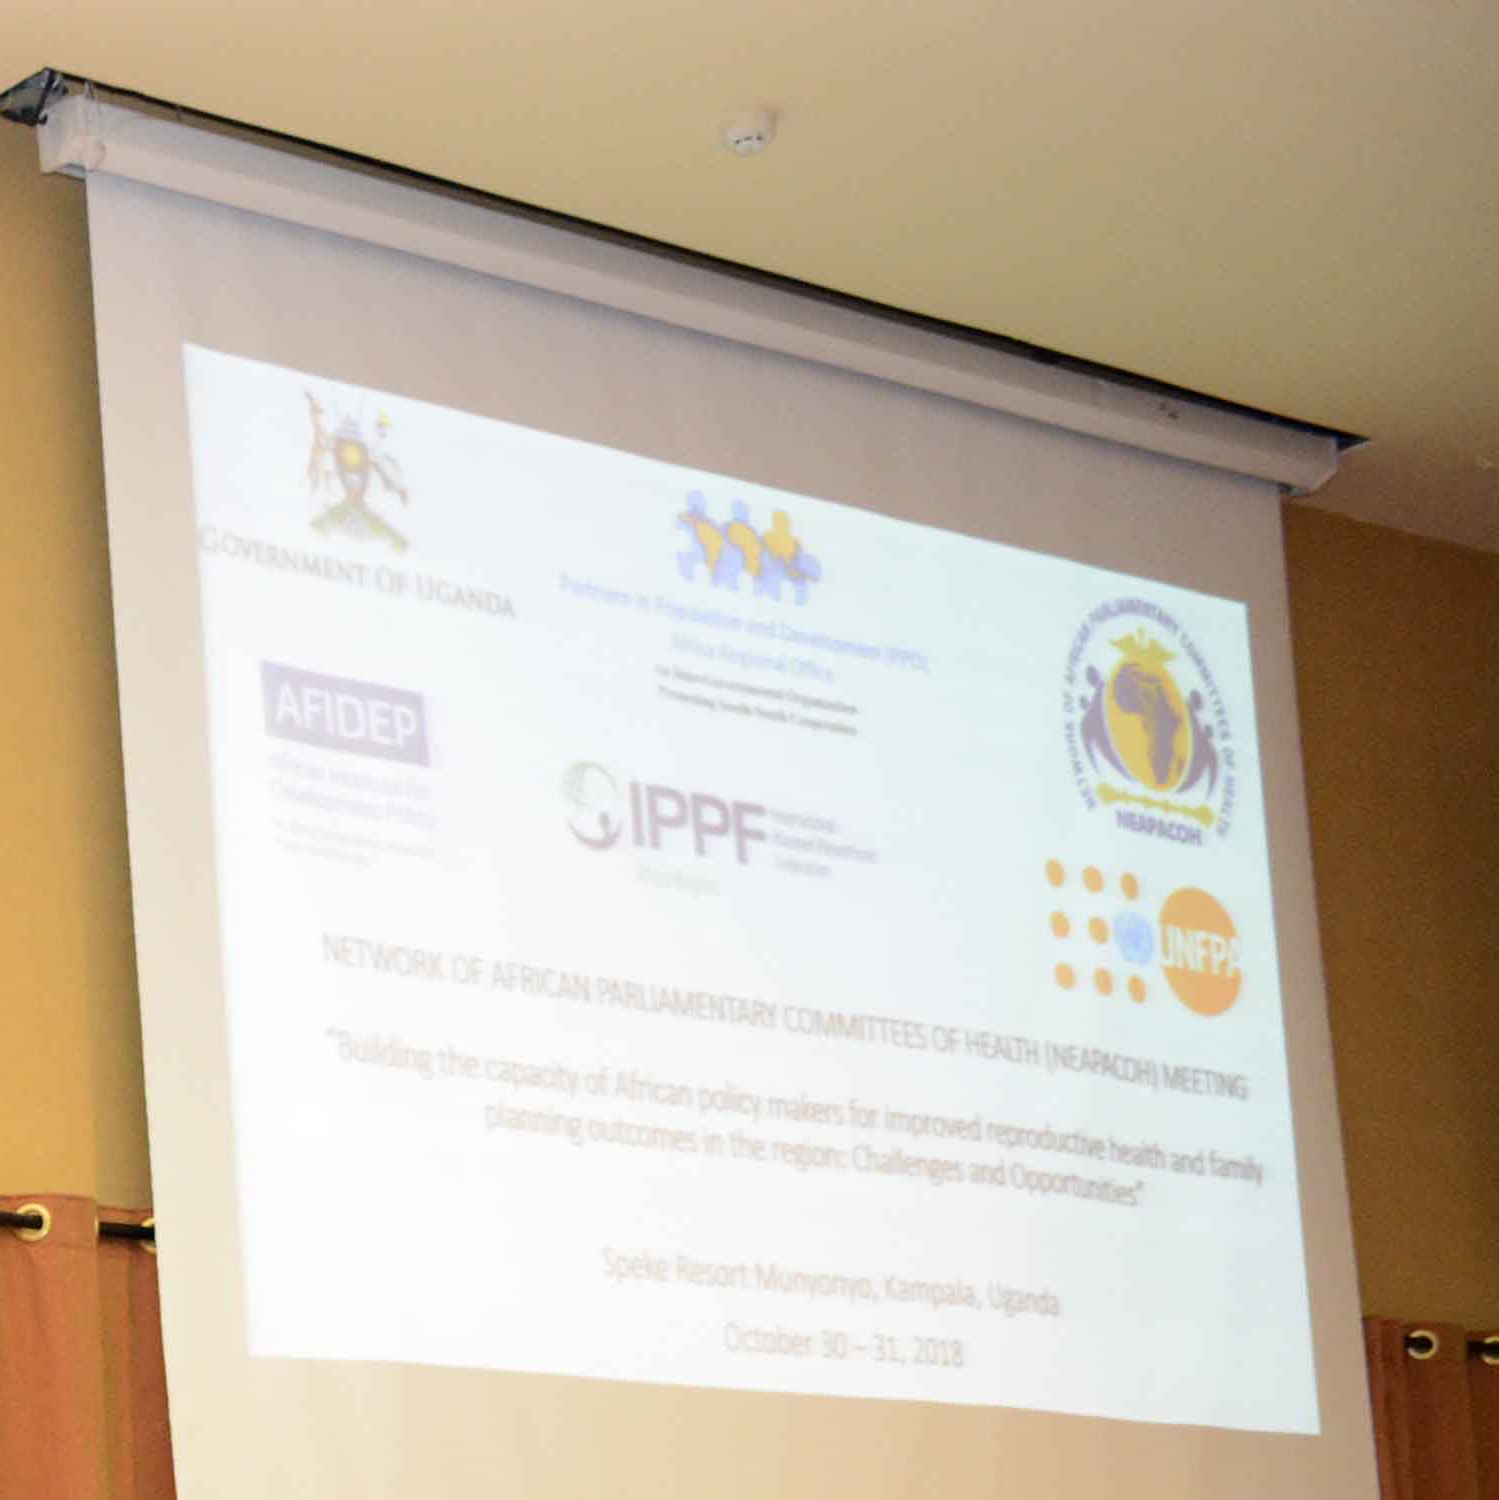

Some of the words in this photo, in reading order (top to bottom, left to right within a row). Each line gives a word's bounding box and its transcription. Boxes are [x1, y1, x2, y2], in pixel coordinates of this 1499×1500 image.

[200, 526, 367, 588] GOVERNMENT
[375, 568, 407, 594] OF
[415, 575, 517, 619] UGANDA
[275, 683, 418, 745] AFIDEP
[628, 781, 766, 865] IPPF
[1161, 927, 1240, 976] UNFPA
[322, 933, 444, 981] NETWORK
[452, 956, 484, 984] OF
[490, 961, 590, 1003] AFRICAN
[597, 977, 778, 1029] PARLIAMENTARY
[784, 1003, 927, 1051] COMMITTEES
[931, 1025, 961, 1053] OF
[966, 1032, 1040, 1065] HEALTH
[1044, 1043, 1159, 1092] (NEAPACOH)
[1162, 1065, 1248, 1100] MEETING
[438, 1046, 479, 1079] the
[485, 1057, 578, 1098] capacity
[585, 1066, 611, 1096] of
[615, 1068, 693, 1108] African
[698, 1081, 762, 1122] policy
[769, 1093, 843, 1126] makers
[850, 1098, 876, 1130] for
[885, 1105, 981, 1144] improved
[987, 1118, 1105, 1162] reproductive
[1109, 1135, 1165, 1168] health
[1170, 1147, 1205, 1176] and
[1208, 1151, 1263, 1188] family
[602, 1248, 668, 1285] Speke
[676, 1255, 747, 1289] Resort
[753, 1261, 879, 1305] Munyonyo,
[884, 1273, 982, 1311] Kampala,
[987, 1279, 1061, 1318] Uganda
[723, 1322, 812, 1356] October
[820, 1328, 848, 1360] 30
[873, 1332, 906, 1364] 31,
[913, 1335, 965, 1369] 2018
